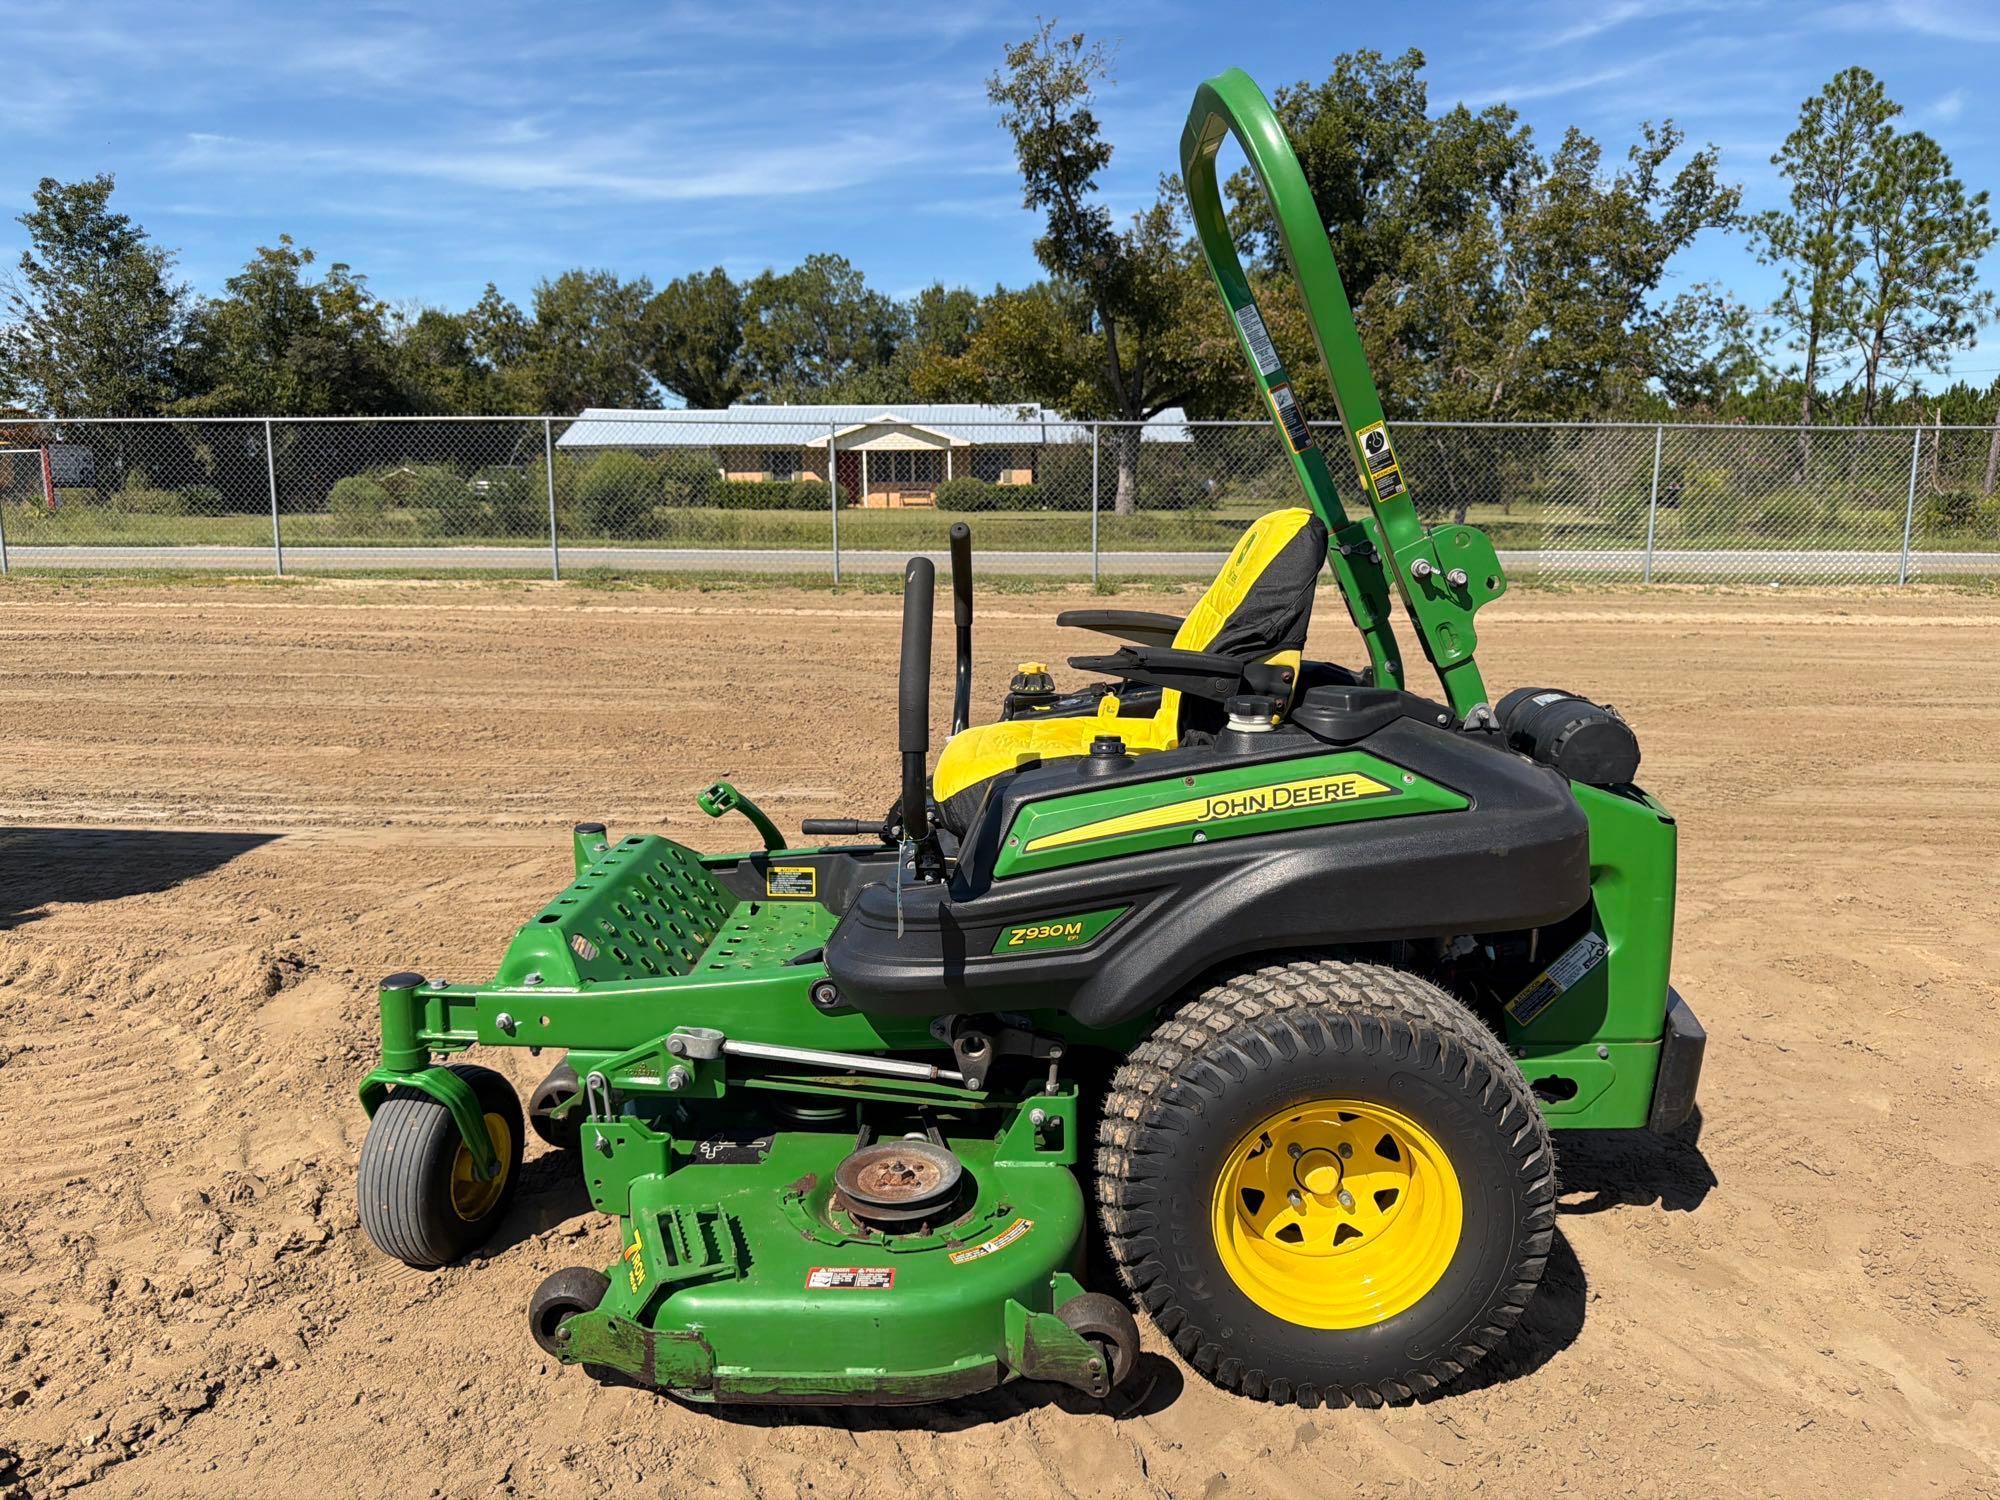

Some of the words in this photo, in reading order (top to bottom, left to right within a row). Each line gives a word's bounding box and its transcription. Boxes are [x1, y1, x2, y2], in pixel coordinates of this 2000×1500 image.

[1198, 794, 1265, 819] JOHN
[1273, 781, 1356, 806] DEERE
[1008, 922, 1082, 946] Z930M
